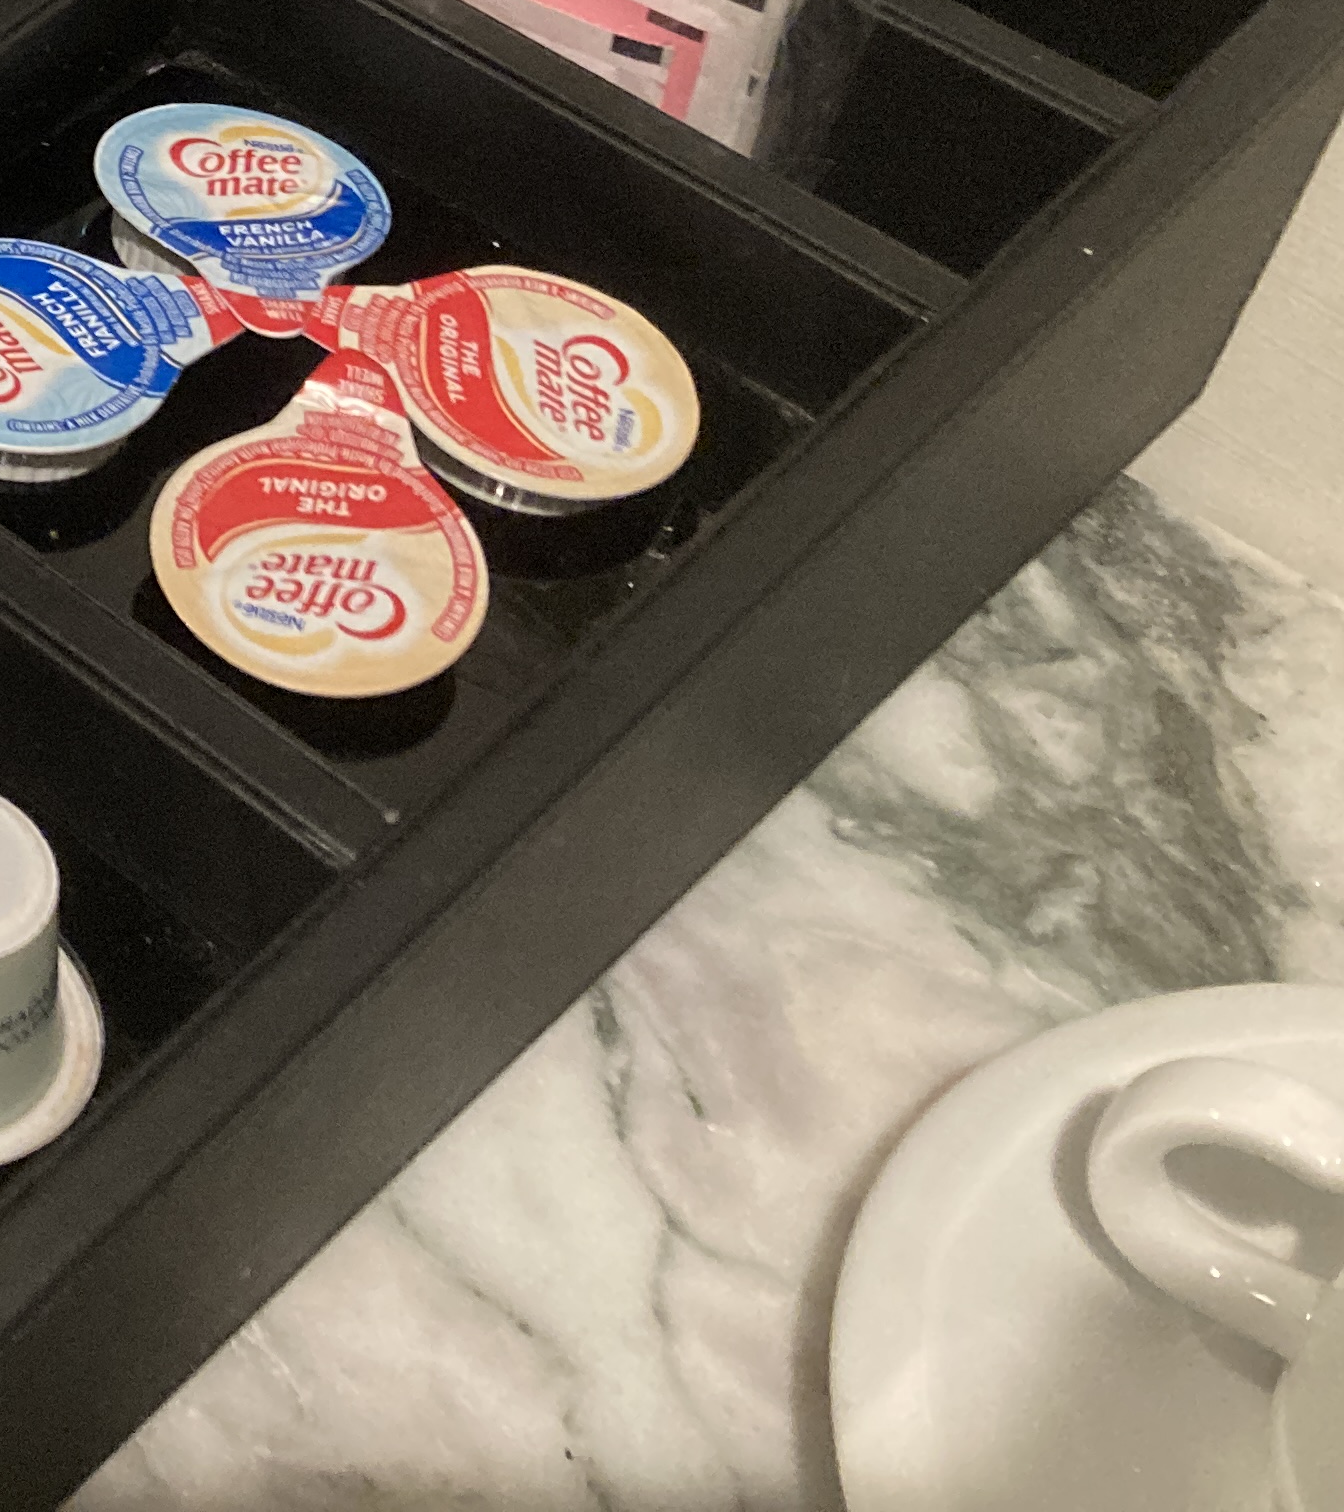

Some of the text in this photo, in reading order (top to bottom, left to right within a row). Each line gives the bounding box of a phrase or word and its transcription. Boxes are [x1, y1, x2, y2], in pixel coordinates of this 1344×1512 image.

[169, 137, 302, 178] Coffee
[207, 177, 299, 196] mate
[219, 220, 313, 236] FRENCH
[227, 230, 325, 247] VANILLA
[31, 292, 109, 358] FRENCH
[50, 280, 121, 351] VANILLA
[438, 313, 468, 403] ORIGINAL
[460, 340, 482, 378] THE
[532, 339, 566, 424] mate
[562, 334, 631, 442] Coffee
[258, 476, 387, 503] ORIGINAL
[296, 498, 351, 517] THE
[257, 552, 378, 586] mate
[245, 574, 406, 641] Coffee
